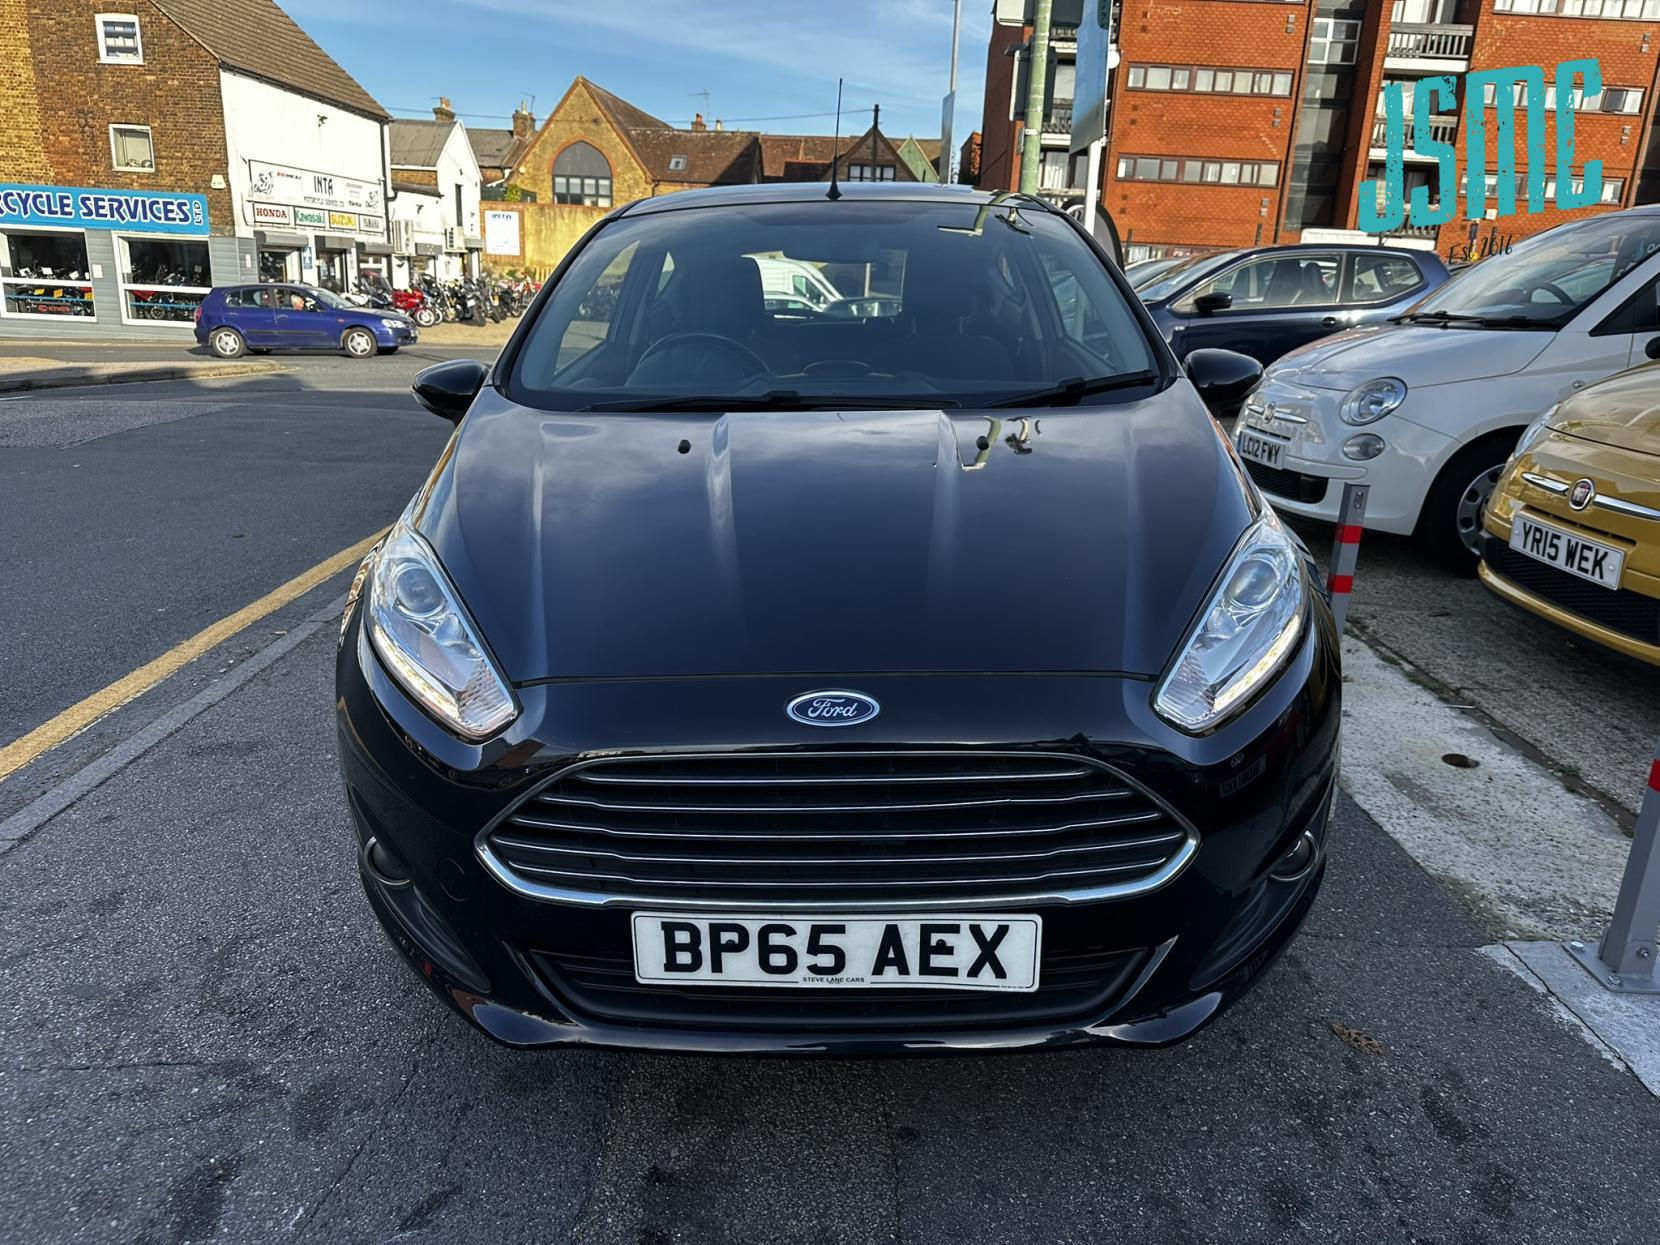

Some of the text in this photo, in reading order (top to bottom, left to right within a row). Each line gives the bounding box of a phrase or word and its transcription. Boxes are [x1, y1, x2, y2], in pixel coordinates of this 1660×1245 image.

[313, 175, 334, 196] INTA
[0, 191, 202, 224] CYCLE SERVICES LTD
[256, 207, 288, 219] HONDA
[295, 209, 326, 224] Kawasaki
[330, 213, 356, 226] SUZUKI
[1242, 435, 1281, 464] LC12 FWY
[1523, 521, 1608, 580] YR15 WEK
[808, 698, 858, 717] Ford
[661, 921, 1010, 979] BP65 AEX
